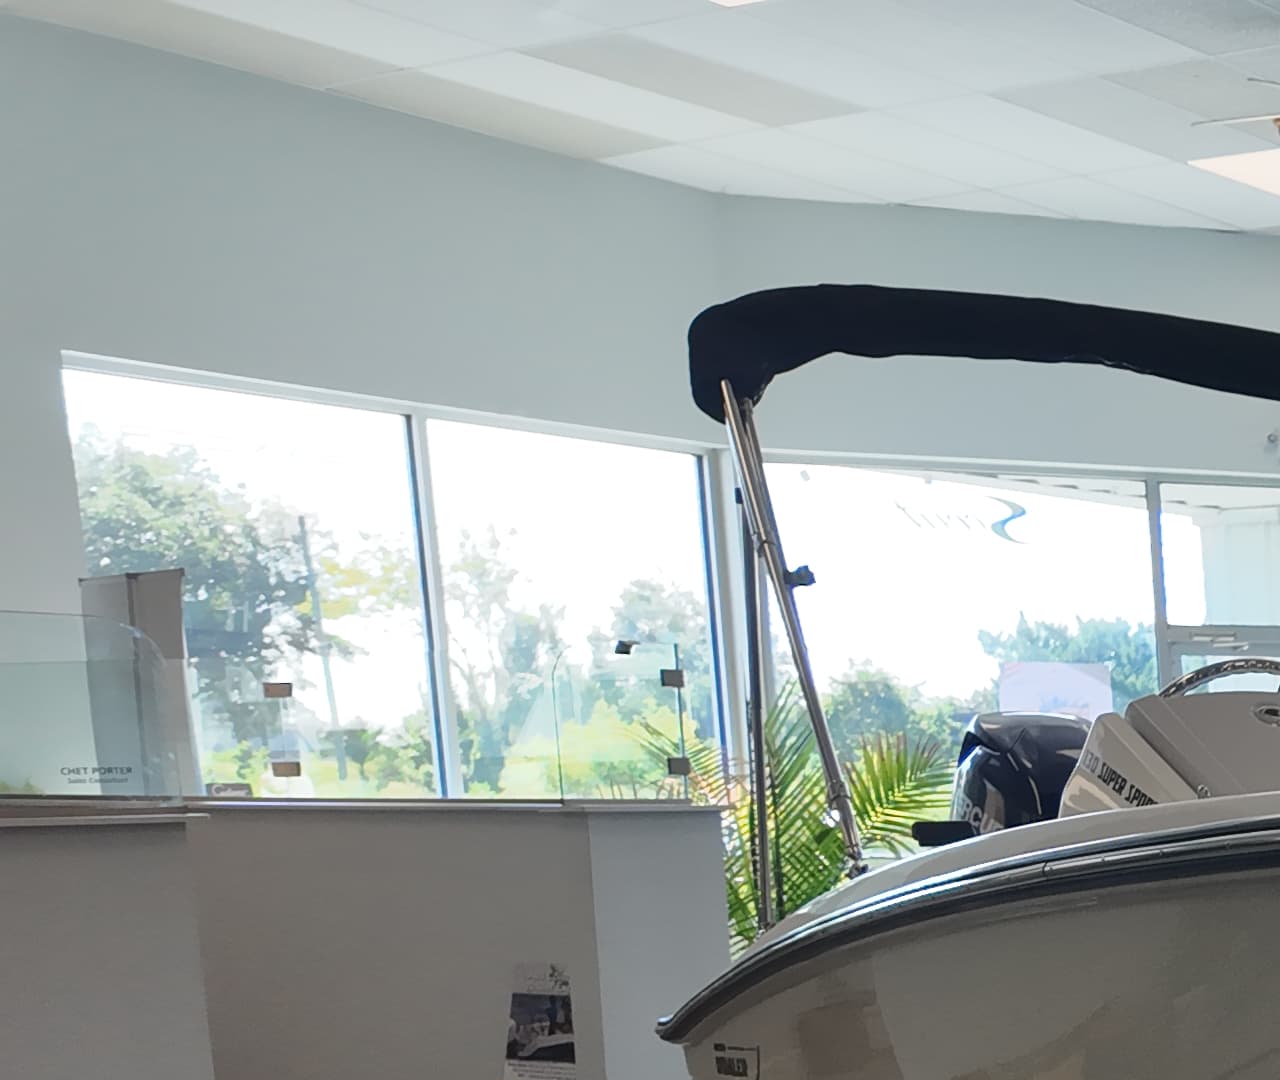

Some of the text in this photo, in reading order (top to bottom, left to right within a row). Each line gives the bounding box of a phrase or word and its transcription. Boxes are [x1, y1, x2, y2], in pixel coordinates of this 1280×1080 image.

[60, 767, 133, 776] CHET PORTER
[1097, 762, 1128, 796] SUPER
